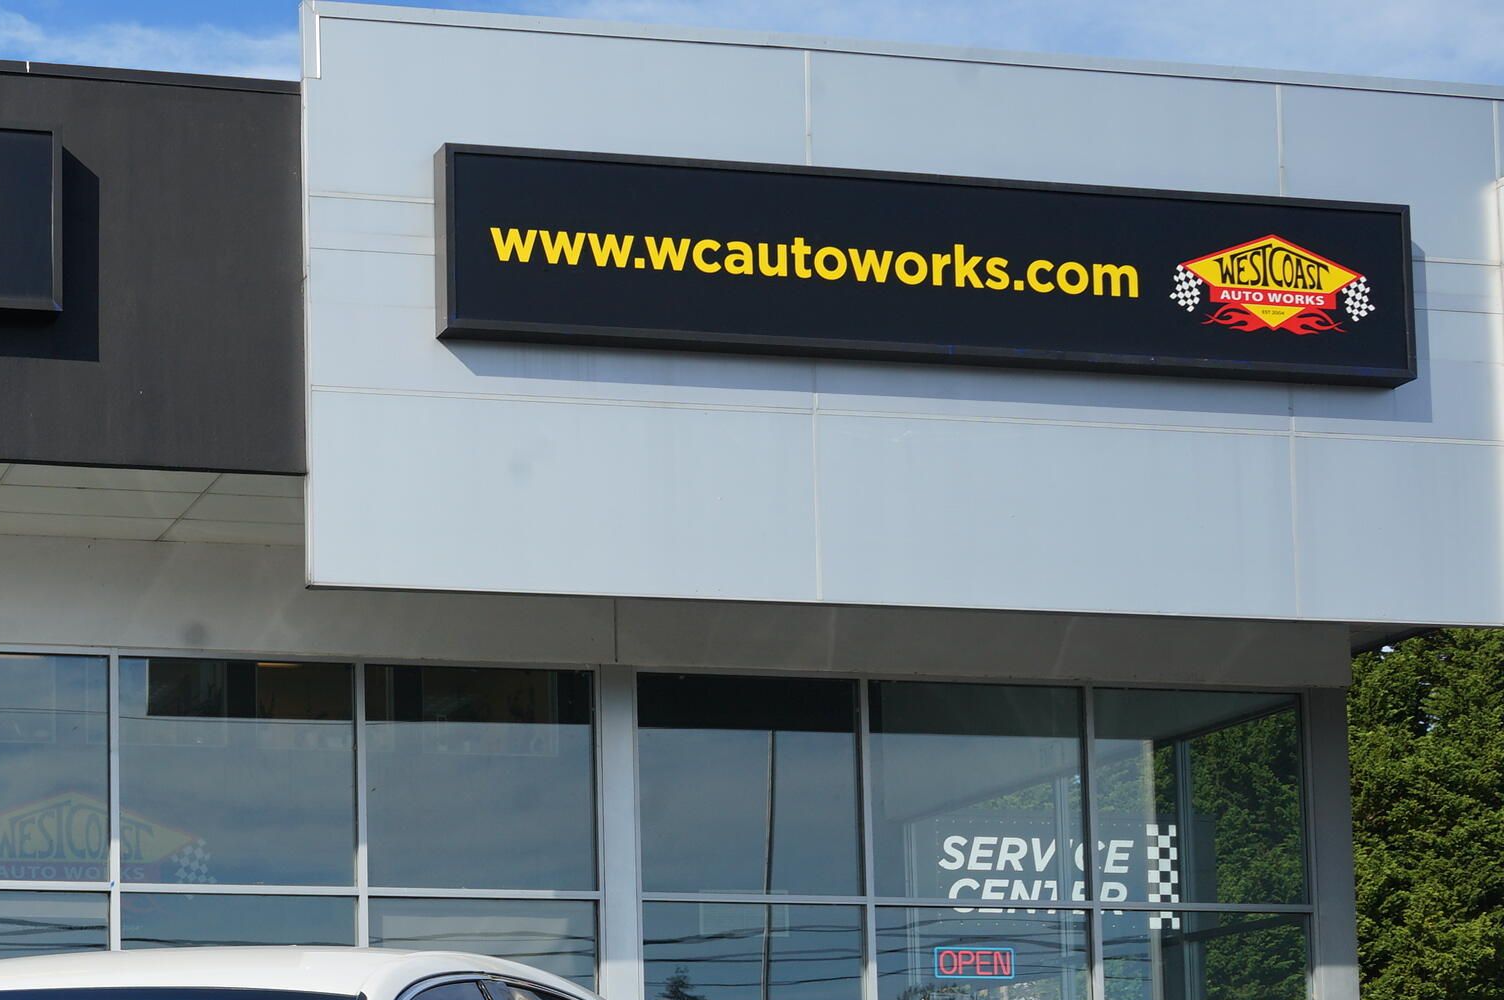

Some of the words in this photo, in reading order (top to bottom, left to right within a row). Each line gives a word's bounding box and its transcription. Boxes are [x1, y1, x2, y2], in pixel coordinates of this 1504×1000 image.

[490, 227, 1139, 298] www.wcautoworks.com
[1220, 290, 1264, 303] AUTO
[1267, 293, 1325, 306] WORKS
[938, 835, 1134, 873] SERVCE
[64, 866, 145, 882] WOKS
[939, 949, 1011, 976] OPEN
